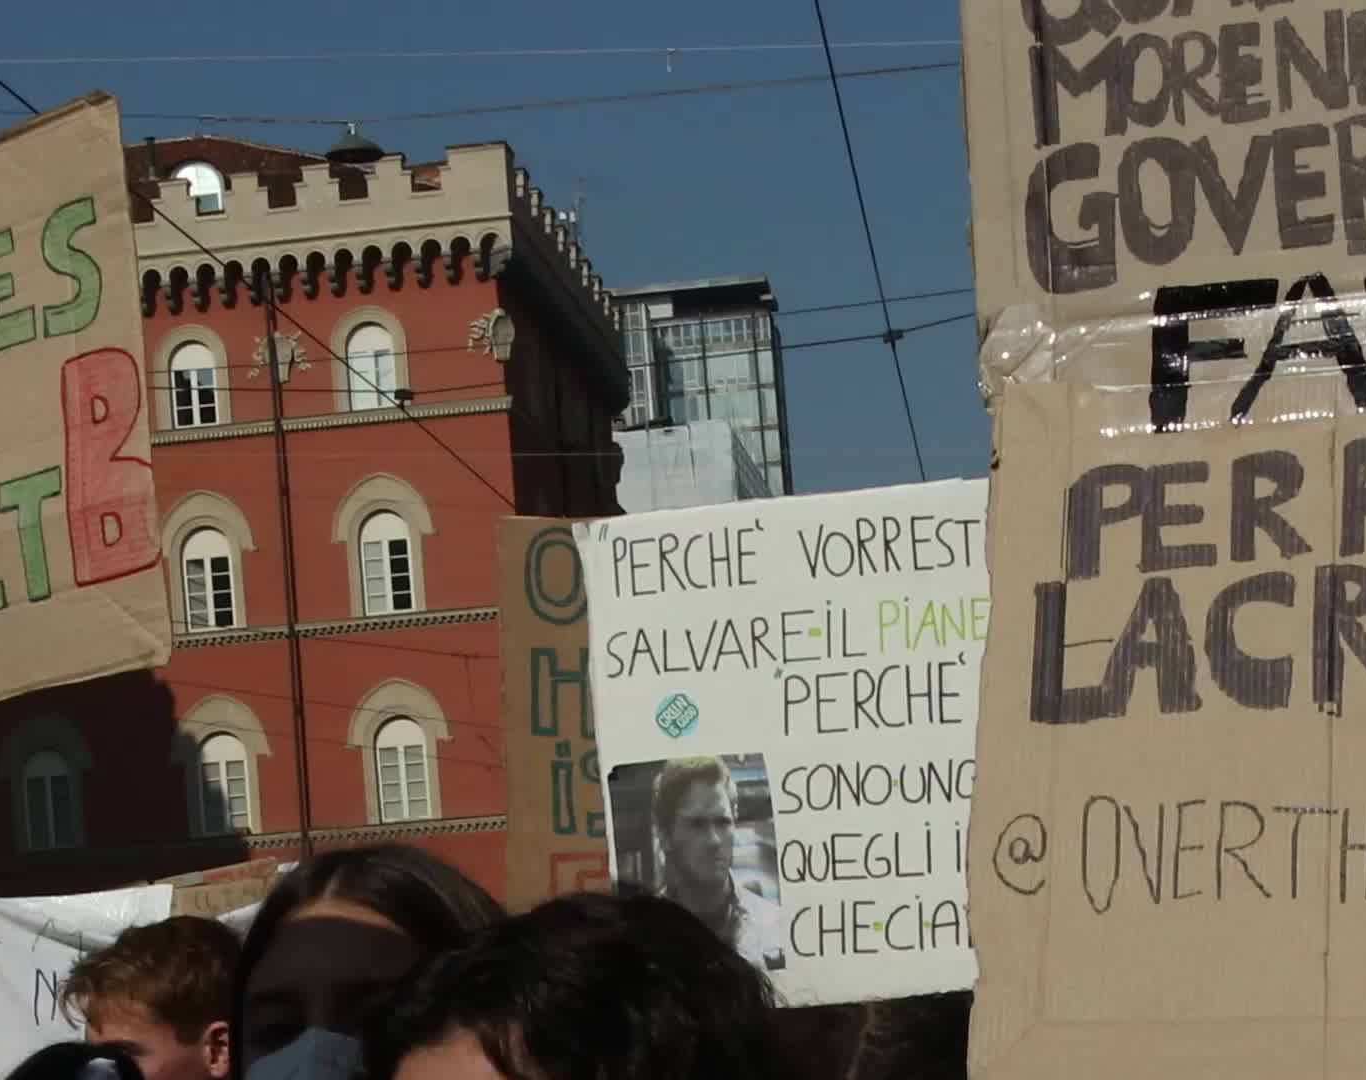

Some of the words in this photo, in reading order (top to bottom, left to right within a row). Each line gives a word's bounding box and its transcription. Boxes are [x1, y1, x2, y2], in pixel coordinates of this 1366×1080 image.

[61, 347, 163, 588] B
[1064, 448, 1313, 580] PER
[606, 609, 821, 678] SALVARE
